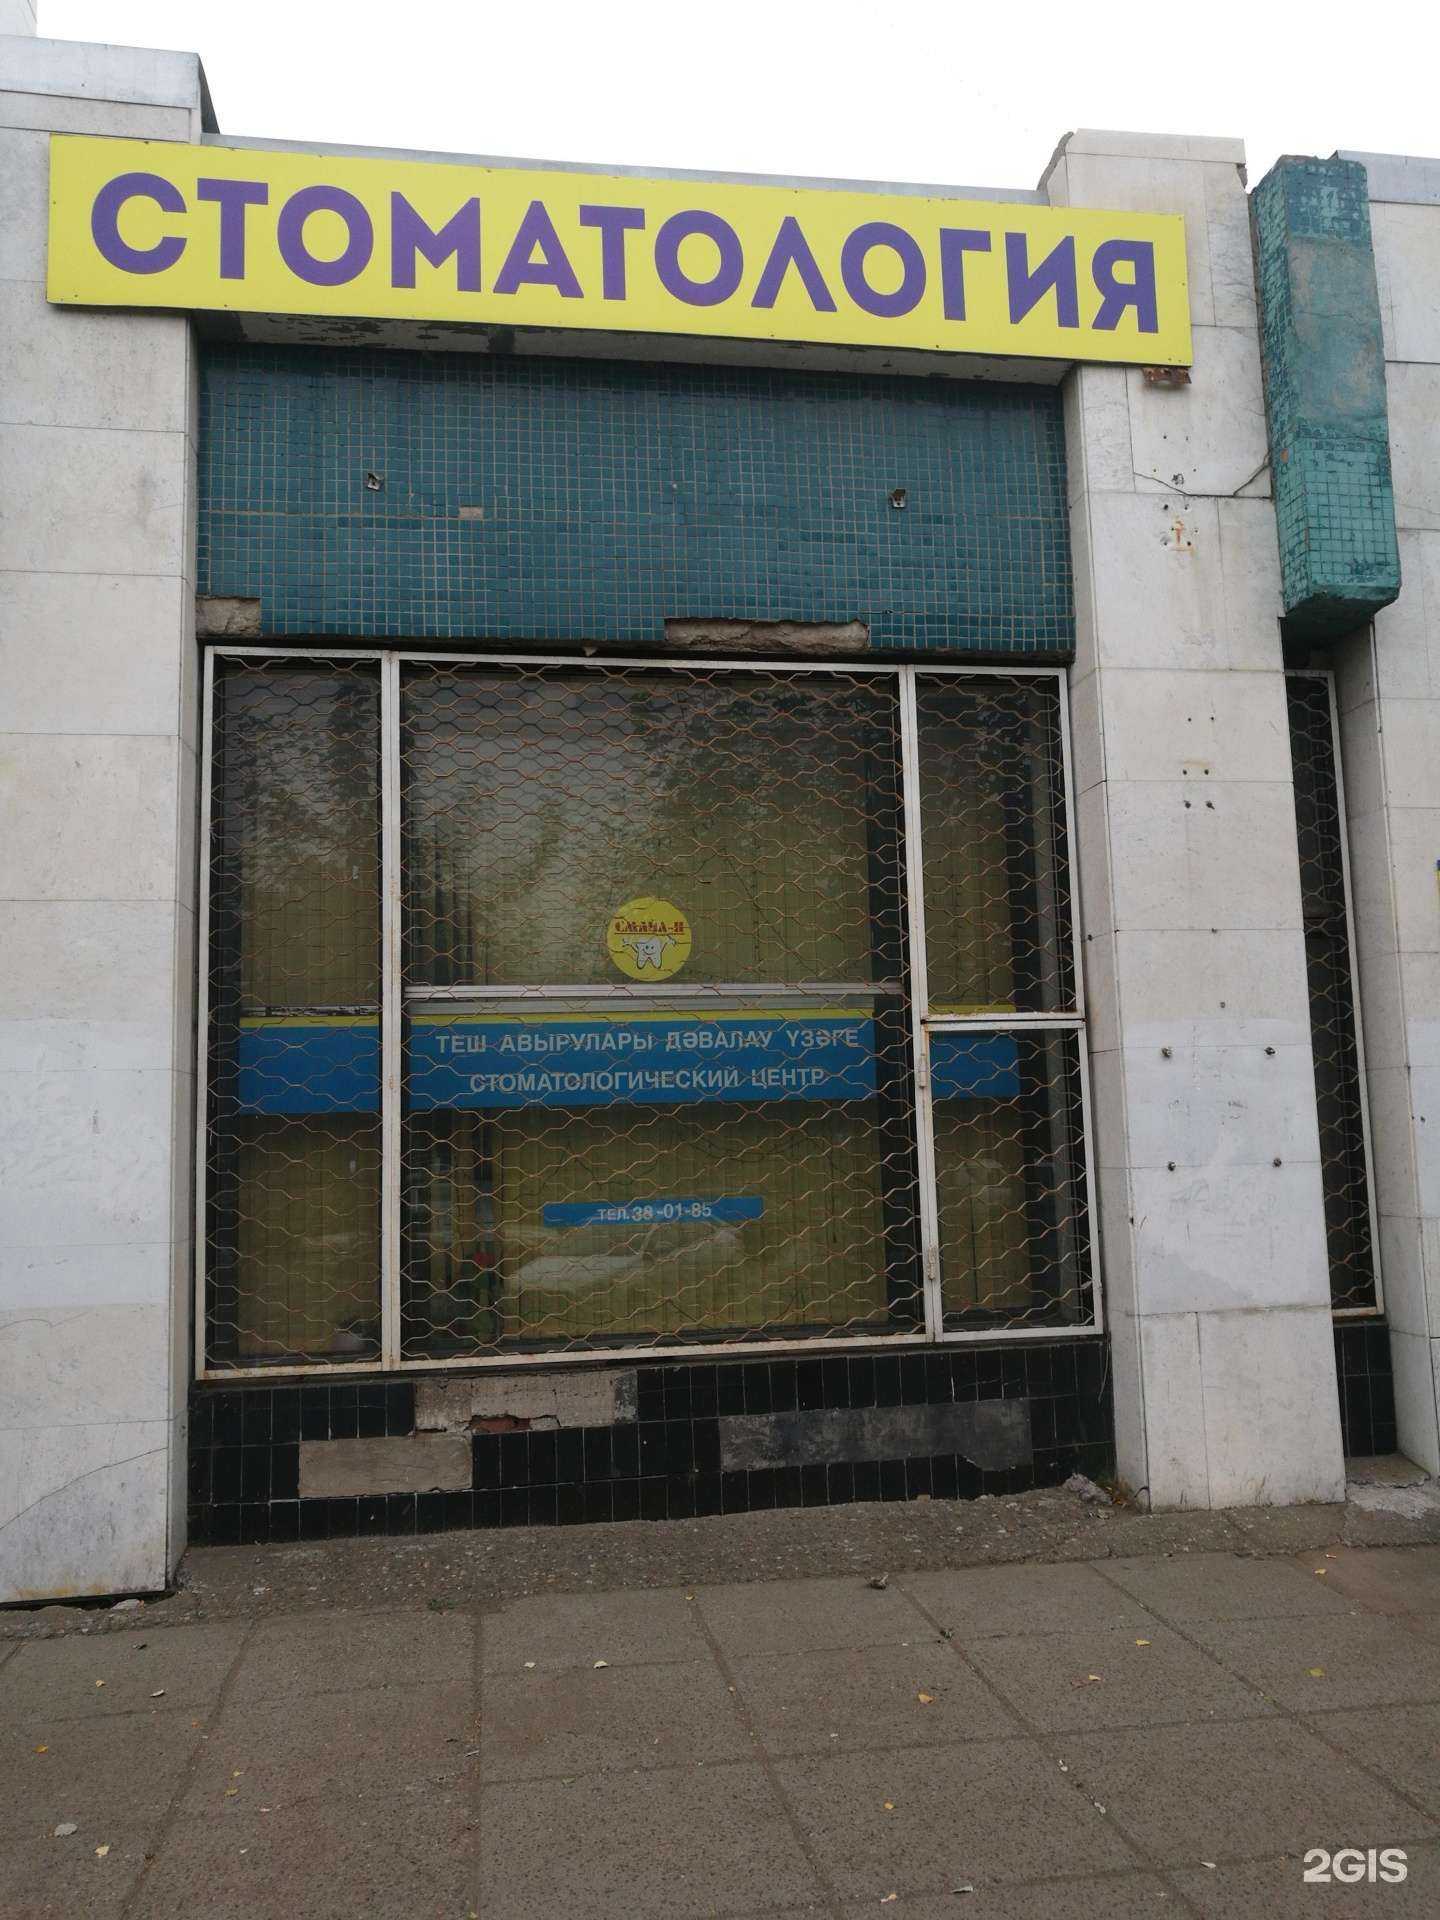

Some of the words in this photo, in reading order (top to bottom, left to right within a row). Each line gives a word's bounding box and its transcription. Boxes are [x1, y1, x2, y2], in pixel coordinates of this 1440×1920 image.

[90, 172, 1160, 334] СТОМАТОЛОГИЯ
[435, 1034, 487, 1054] ТЕШ
[500, 1032, 654, 1053] АВЫРУЛАРЫ
[665, 1030, 773, 1052] ДӘВАЛАУ
[470, 1066, 739, 1093] СТОМАТОЛОГИЧЕСКИЙ
[750, 1068, 826, 1089] ЦЕНТР
